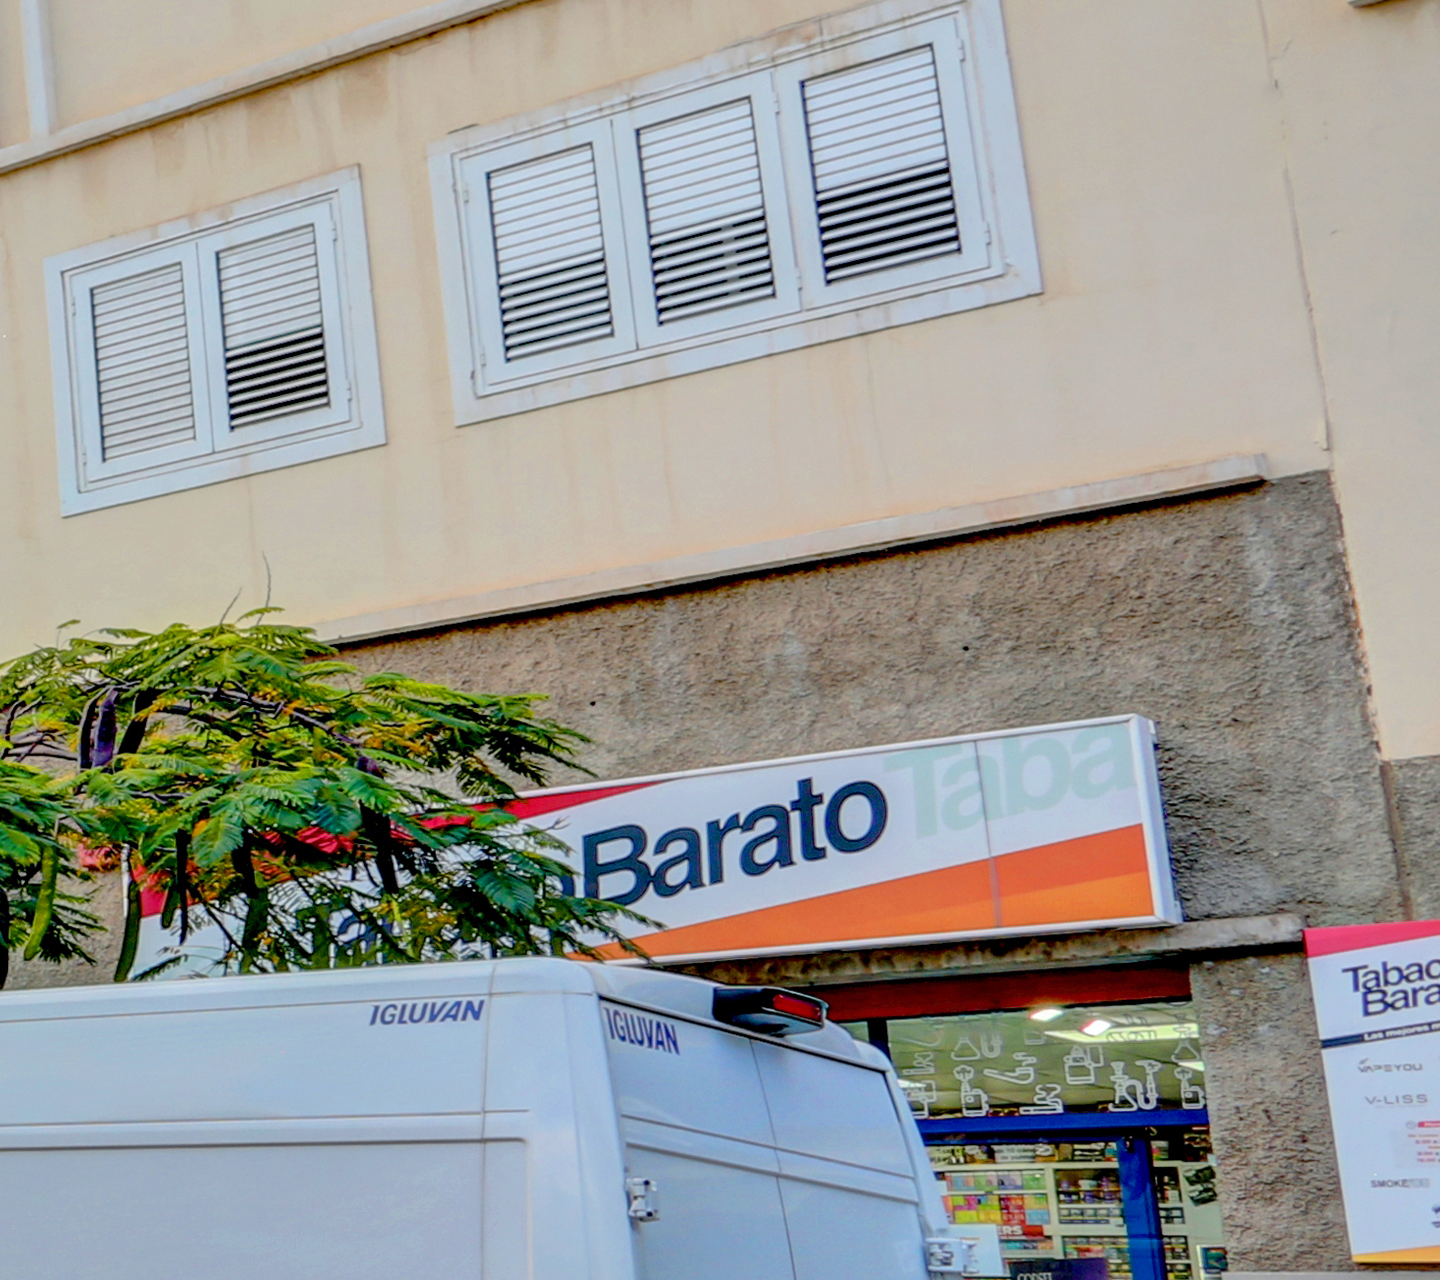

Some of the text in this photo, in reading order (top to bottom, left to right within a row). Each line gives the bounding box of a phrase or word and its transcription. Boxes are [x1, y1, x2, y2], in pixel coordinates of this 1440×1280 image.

[884, 735, 1137, 840] Taba
[582, 777, 888, 907] Barato
[369, 999, 485, 1026] IGLUVAN
[603, 1007, 680, 1056] IGLUVAN
[1364, 1031, 1384, 1041] Las
[1386, 1024, 1430, 1038] mejores
[1364, 1093, 1428, 1105] V-LISS
